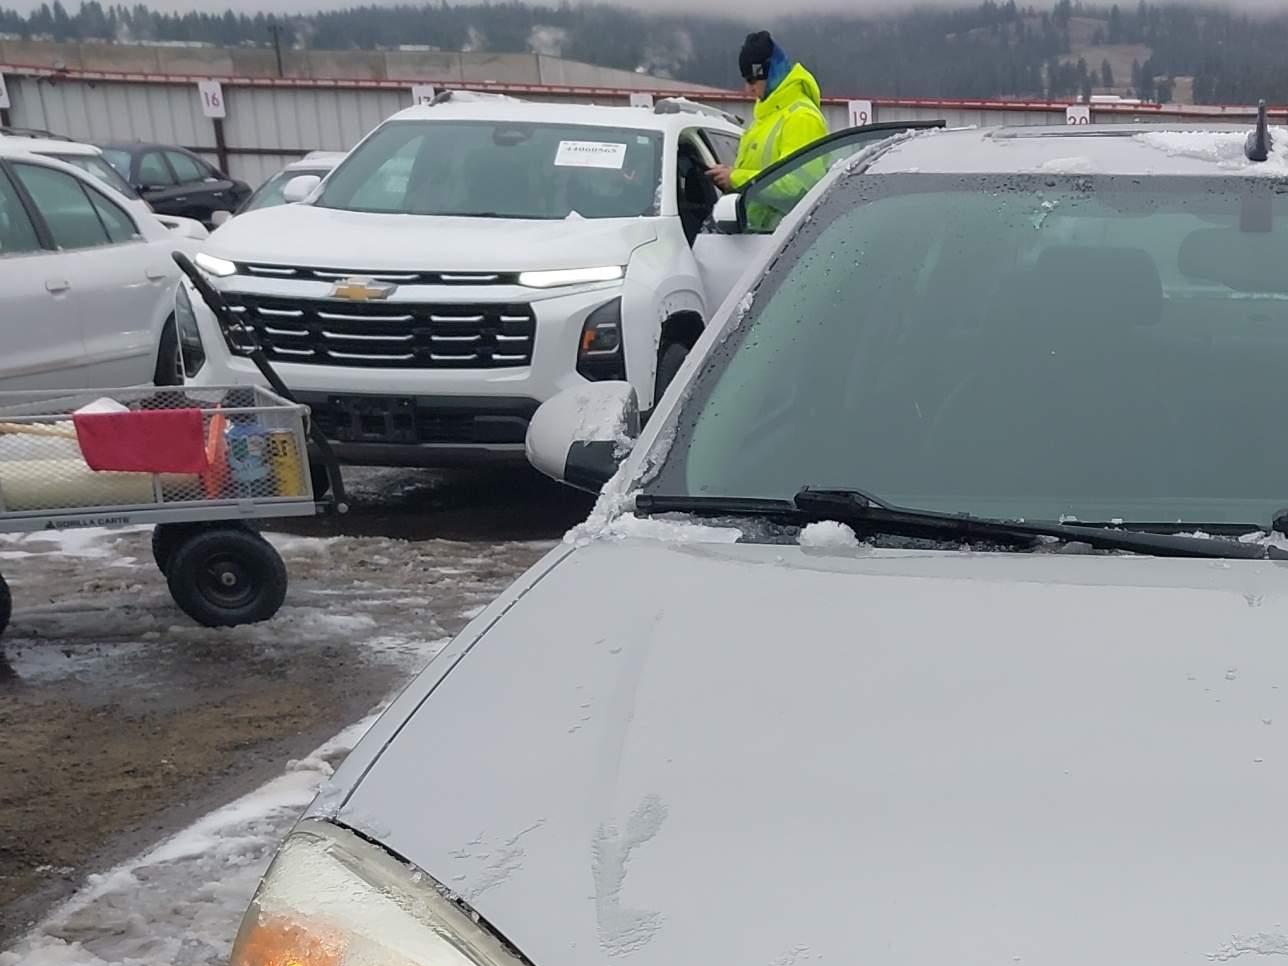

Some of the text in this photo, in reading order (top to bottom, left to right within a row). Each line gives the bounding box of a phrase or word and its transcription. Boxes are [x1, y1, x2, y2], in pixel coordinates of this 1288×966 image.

[203, 92, 220, 107] 16
[853, 111, 868, 125] 19
[56, 518, 96, 529] GORILLA
